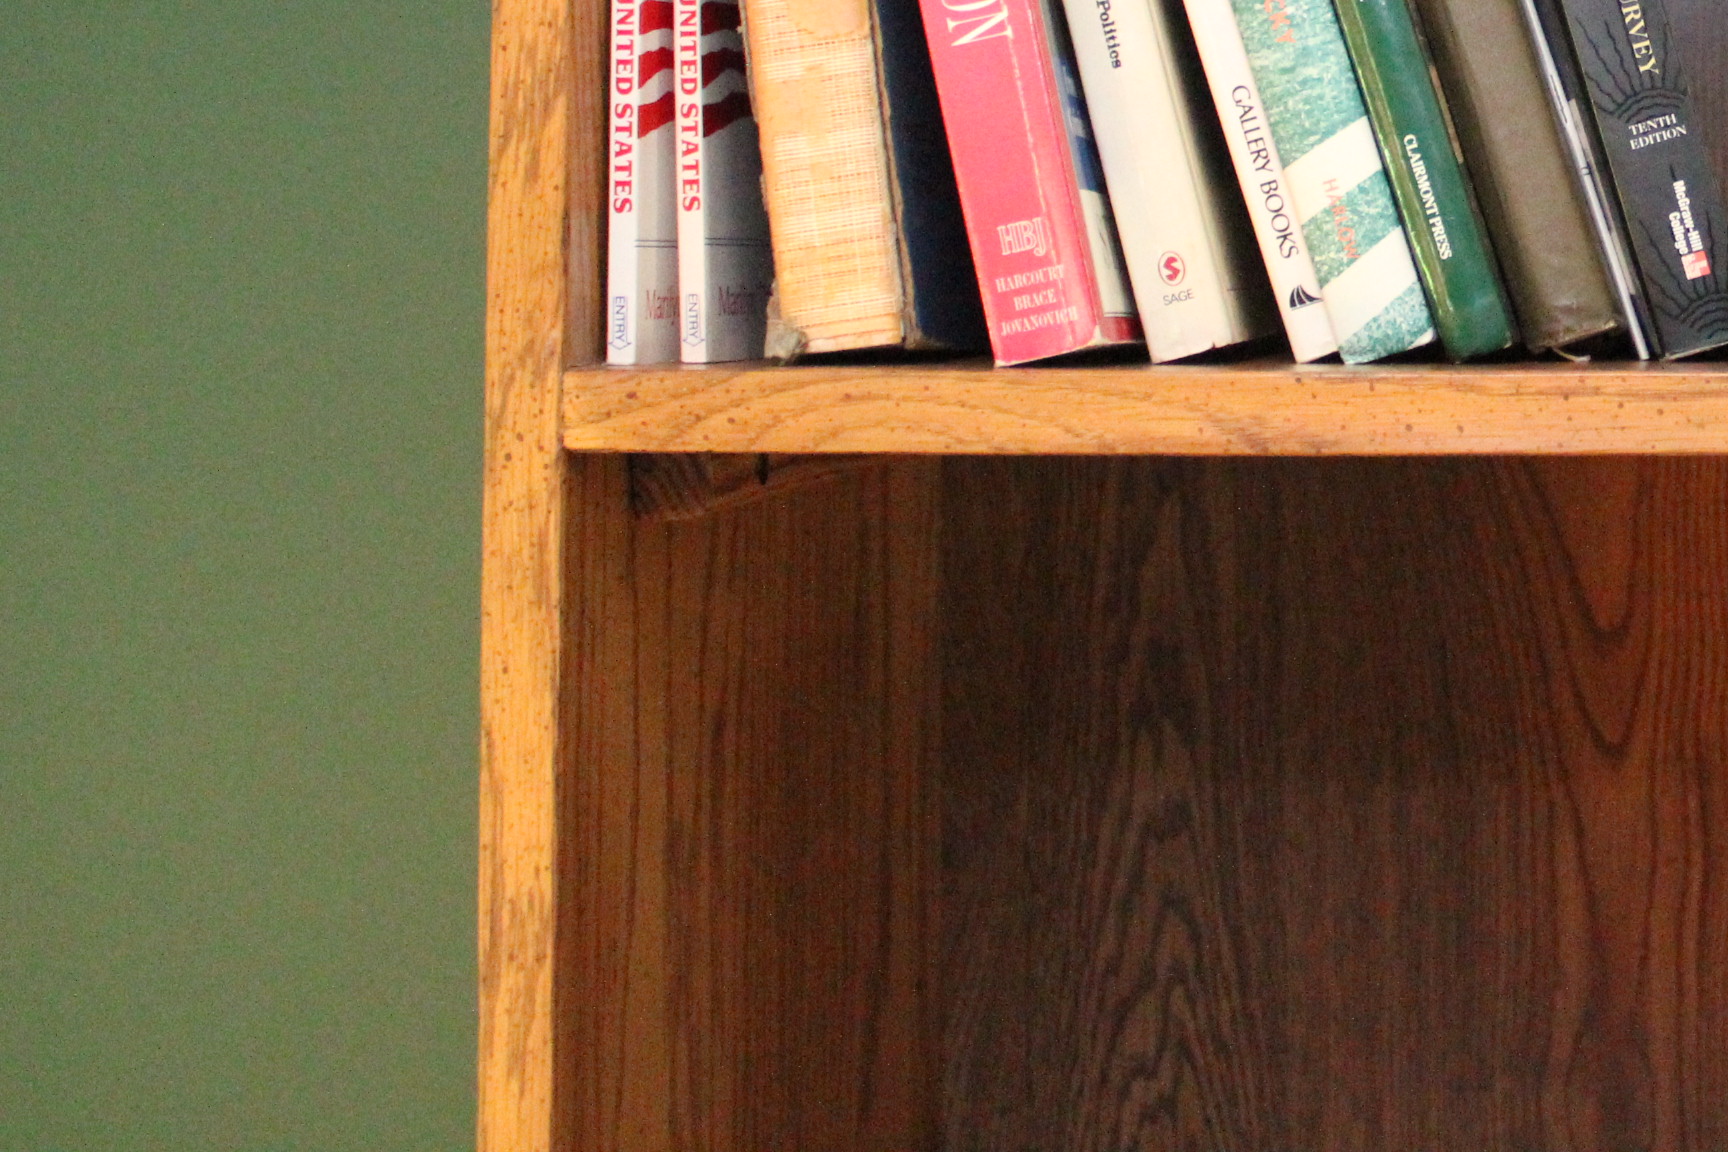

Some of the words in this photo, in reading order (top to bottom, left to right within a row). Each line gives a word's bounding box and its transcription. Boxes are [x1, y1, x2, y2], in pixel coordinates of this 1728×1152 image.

[1628, 113, 1677, 136] TENTH
[1629, 125, 1687, 150] EDITION
[613, 103, 633, 214] STATES
[680, 103, 700, 212] STATES
[1231, 85, 1273, 174] GALLERY
[1259, 179, 1299, 259] BOOKS
[1322, 178, 1361, 259] HARLOW
[1403, 133, 1440, 217] CLAIRMONT
[1429, 215, 1452, 260] PRESS
[1672, 179, 1704, 252] McGraw-Hill
[997, 217, 1047, 256] HBJ
[1668, 211, 1689, 255] College
[995, 264, 1065, 293] HARCOURT
[1014, 289, 1057, 311] BRACE
[1163, 289, 1194, 306] SAGE
[615, 296, 625, 342] ENTRY
[688, 293, 698, 338] ENTRY
[1000, 306, 1079, 337] JOVANOVICH
